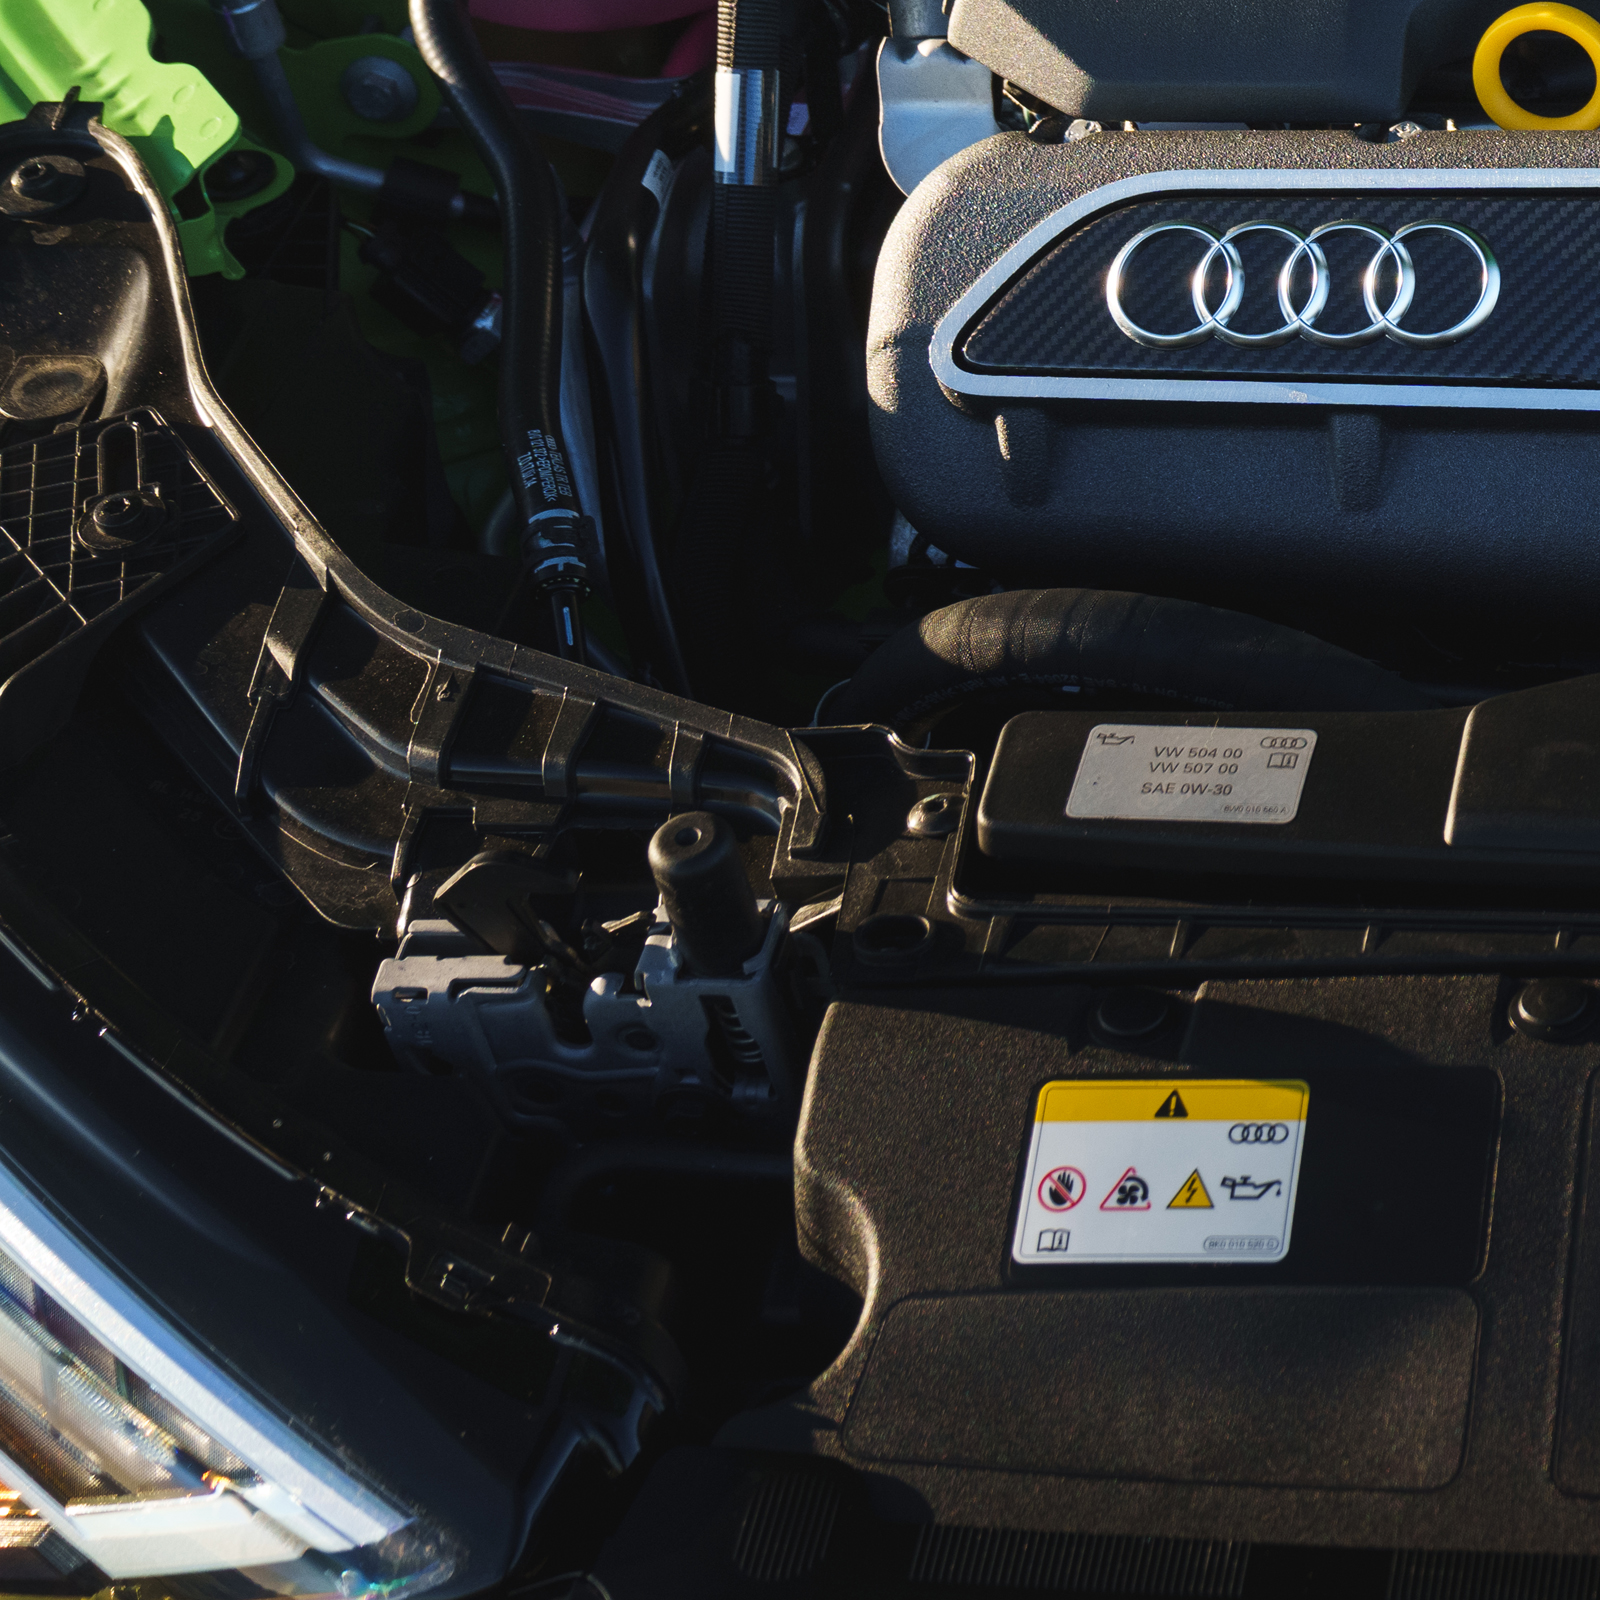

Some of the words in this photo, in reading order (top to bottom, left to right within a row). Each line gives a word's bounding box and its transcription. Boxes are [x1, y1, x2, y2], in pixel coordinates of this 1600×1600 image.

[1154, 746, 1185, 759] VW
[1187, 747, 1217, 760] 504
[1222, 747, 1243, 760] 00
[1149, 761, 1180, 774] VW
[1183, 762, 1213, 775] 507
[1217, 762, 1239, 775] 00
[1141, 781, 1175, 795] SAE
[1180, 782, 1233, 796] 0W-30
